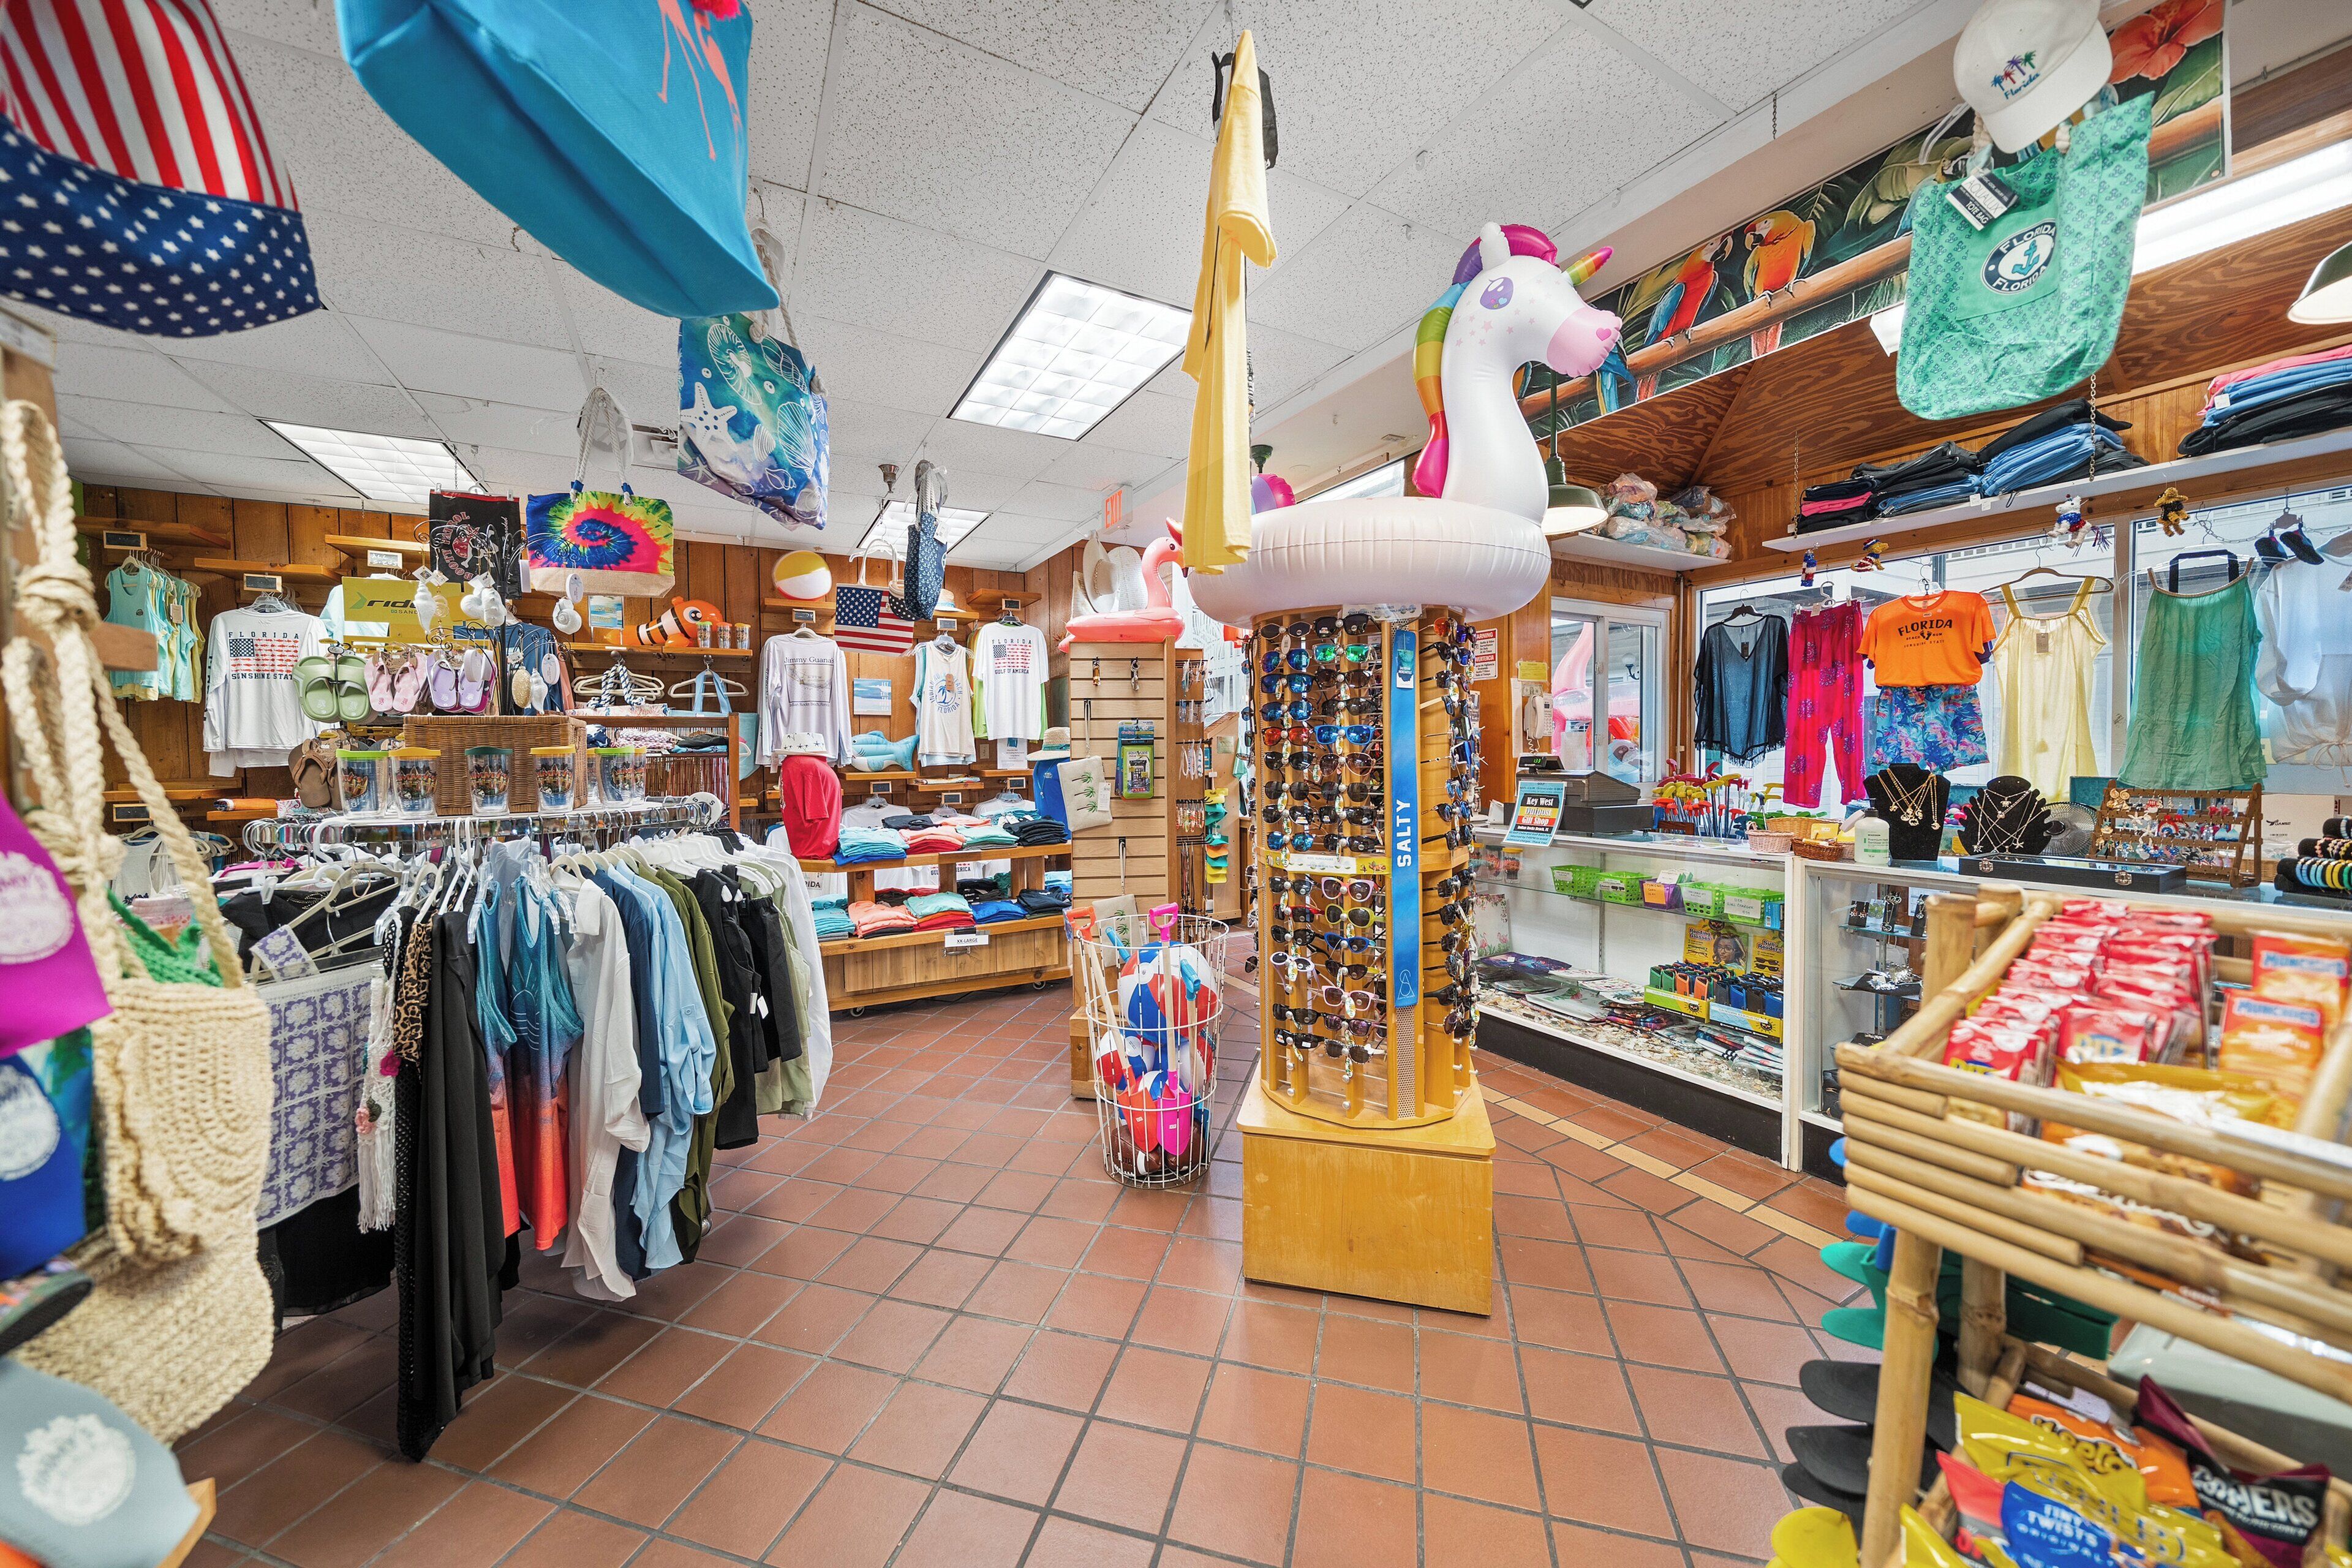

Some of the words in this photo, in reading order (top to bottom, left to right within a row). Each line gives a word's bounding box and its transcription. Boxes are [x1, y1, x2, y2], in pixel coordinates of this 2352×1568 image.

[2004, 73, 2040, 100] Florida
[1967, 179, 2003, 214] AQUALUX
[1966, 201, 1980, 216] TOTE
[1975, 211, 1989, 224] BAG
[1999, 224, 2056, 254] FLORIDA
[1992, 265, 2047, 292] FLORIDA
[1105, 490, 1123, 529] EXIT
[442, 511, 470, 545] PATROL
[442, 548, 474, 580] BOOTY
[228, 631, 299, 639] FLORIDA
[1898, 619, 1953, 636] FLORIDA
[937, 702, 960, 714] FLORIDA
[1526, 797, 1538, 806] Key
[1539, 797, 1554, 806] West
[1526, 808, 1552, 816] Outpost
[1396, 799, 1412, 867] SALTY
[1689, 928, 1711, 937] Reading
[1757, 943, 1783, 953] Readers
[2028, 1510, 2099, 1547] TWISTS
[2043, 1504, 2083, 1527] TINY
[2016, 1523, 2114, 1567] ORIGINAL
